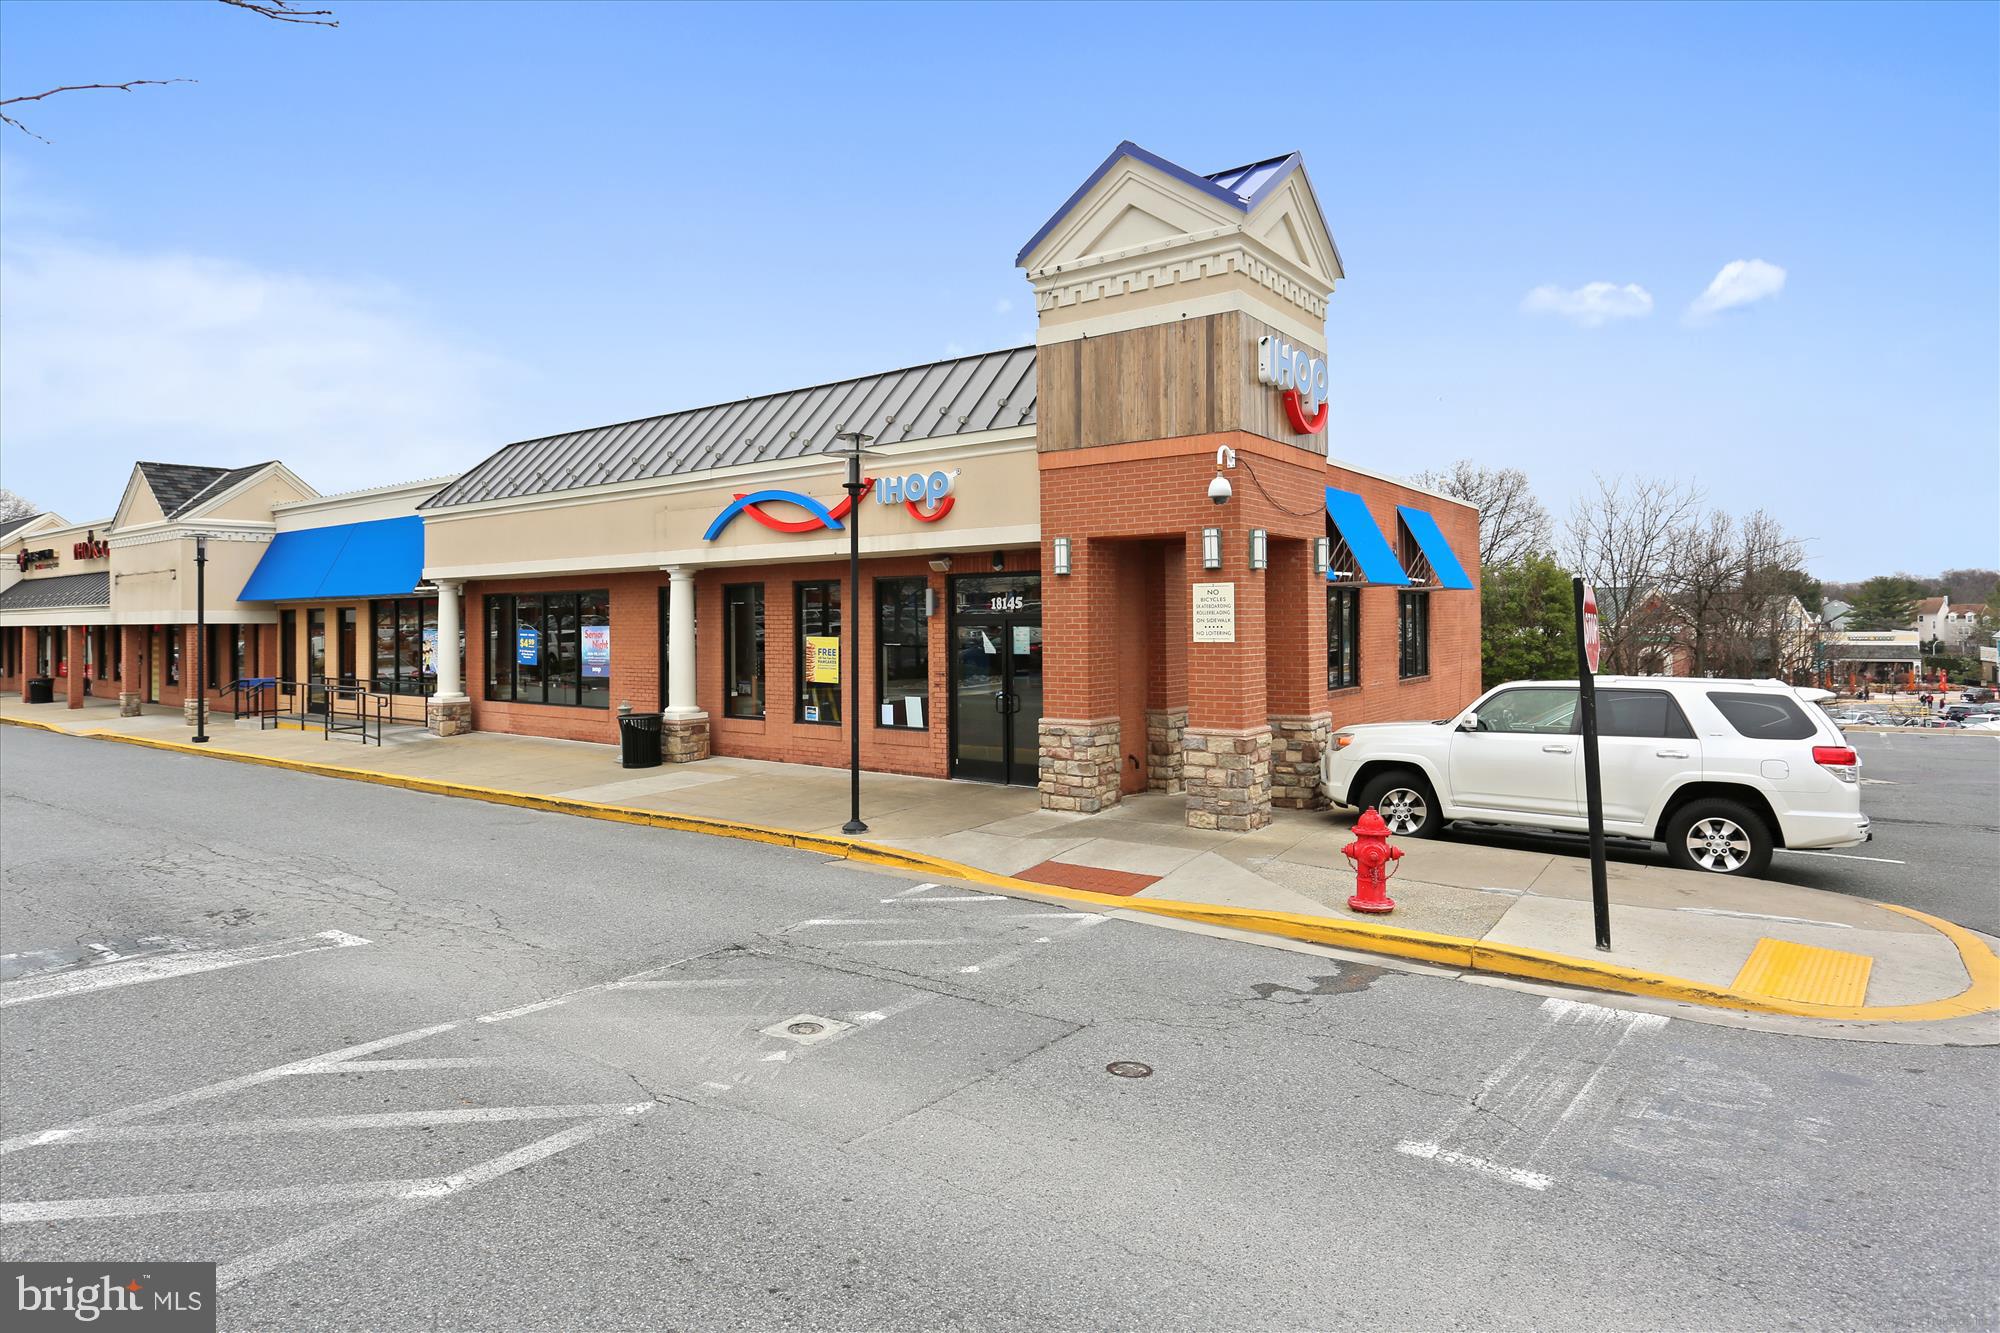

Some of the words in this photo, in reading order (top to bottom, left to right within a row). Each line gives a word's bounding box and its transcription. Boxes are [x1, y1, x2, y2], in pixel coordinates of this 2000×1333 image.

[1261, 335, 1328, 416] IHOP
[875, 471, 951, 510] IHOP
[990, 596, 1023, 610] 18145
[817, 648, 837, 657] FREE
